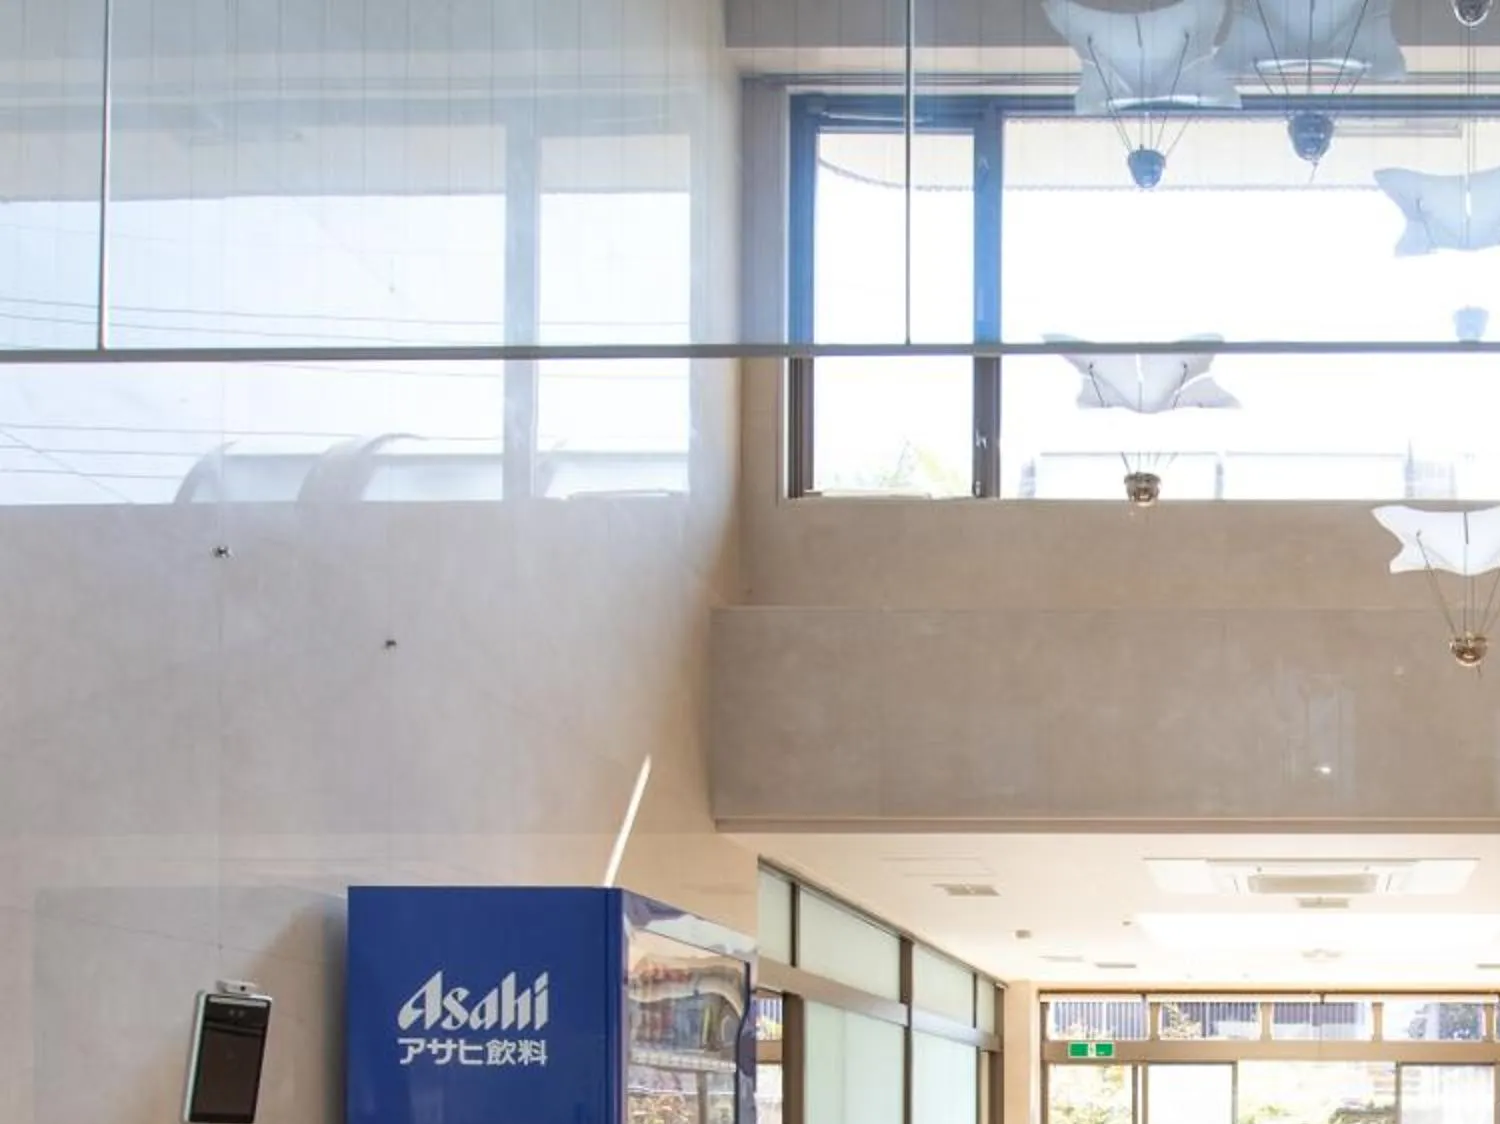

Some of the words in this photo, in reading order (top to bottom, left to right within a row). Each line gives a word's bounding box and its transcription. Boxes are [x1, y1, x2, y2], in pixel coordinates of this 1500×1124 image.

[397, 971, 548, 1029] Asahi
[398, 1038, 547, 1065] アサヒ飲料
